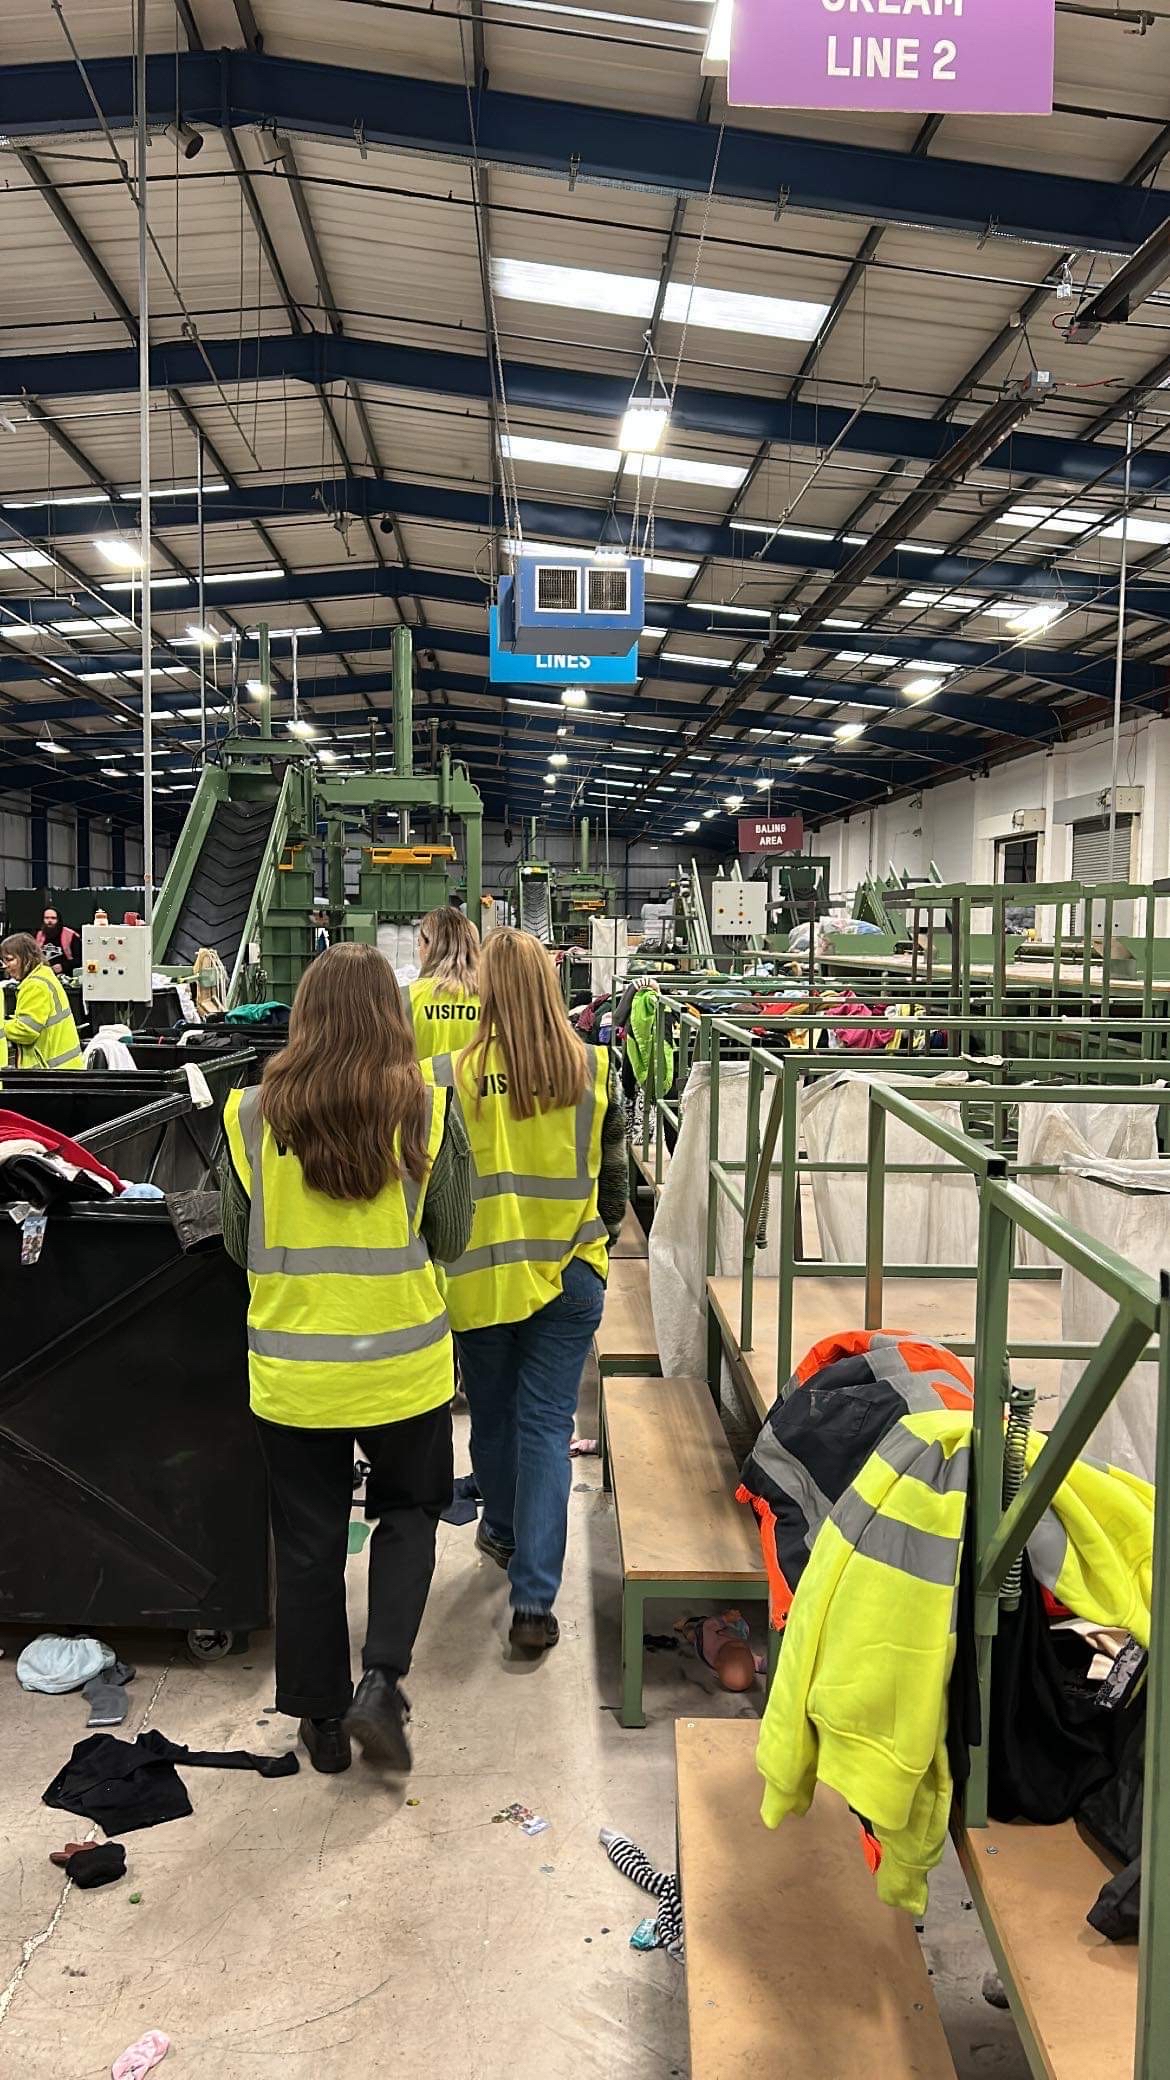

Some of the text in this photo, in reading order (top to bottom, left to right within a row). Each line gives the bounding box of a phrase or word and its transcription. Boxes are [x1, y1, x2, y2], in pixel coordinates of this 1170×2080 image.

[827, 35, 957, 80] LINE 2
[535, 654, 592, 669] LINES
[755, 823, 787, 834] BALING
[759, 835, 783, 846] AREA
[424, 1004, 480, 1021] VISITO
